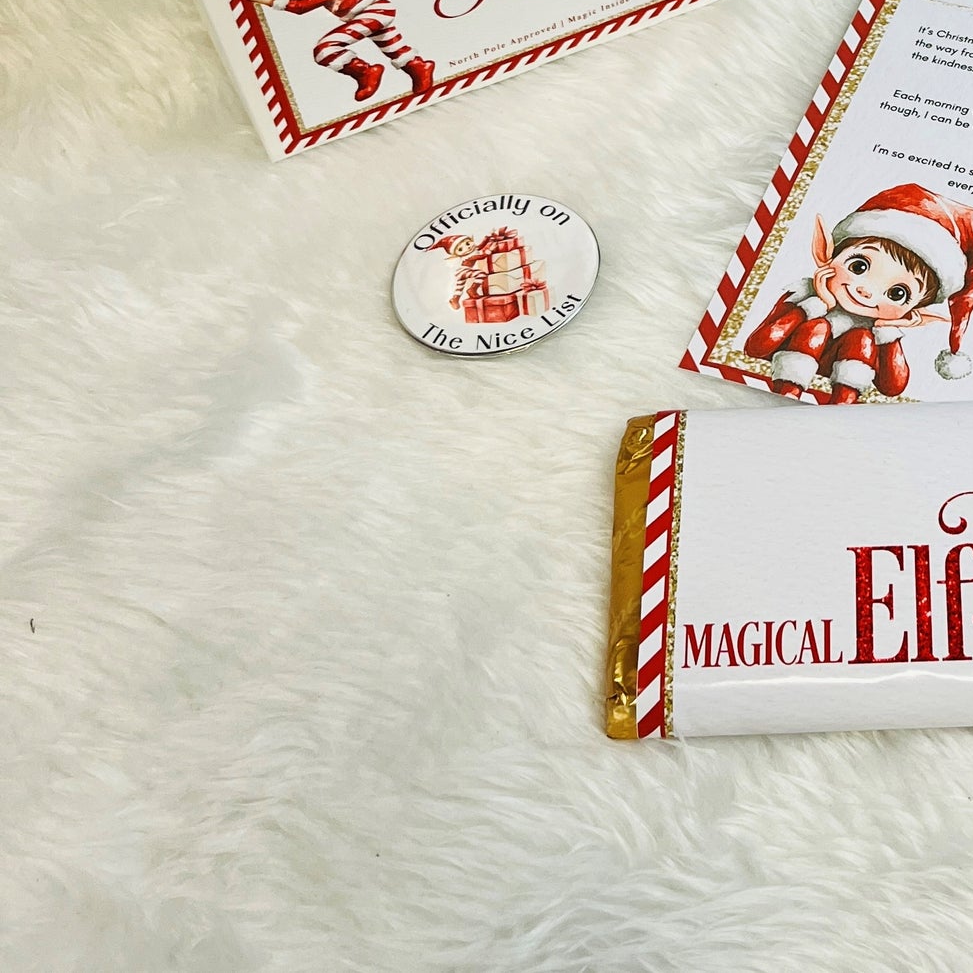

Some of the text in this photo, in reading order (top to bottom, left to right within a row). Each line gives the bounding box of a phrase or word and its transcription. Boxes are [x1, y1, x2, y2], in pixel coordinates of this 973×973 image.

[449, 52, 479, 67] North
[484, 42, 506, 54] Pole
[510, 22, 557, 45] Approved
[568, 9, 597, 23] Magic
[918, 25, 934, 35] It's
[911, 50, 930, 62] the
[892, 88, 922, 103] Each
[924, 97, 971, 116] morning
[872, 143, 890, 155] I'm
[891, 150, 906, 159] so
[907, 154, 953, 170] excited
[954, 163, 967, 173] to
[414, 195, 571, 251] Officially on
[421, 294, 582, 350] The Nice List
[682, 618, 843, 670] MAGICAL
